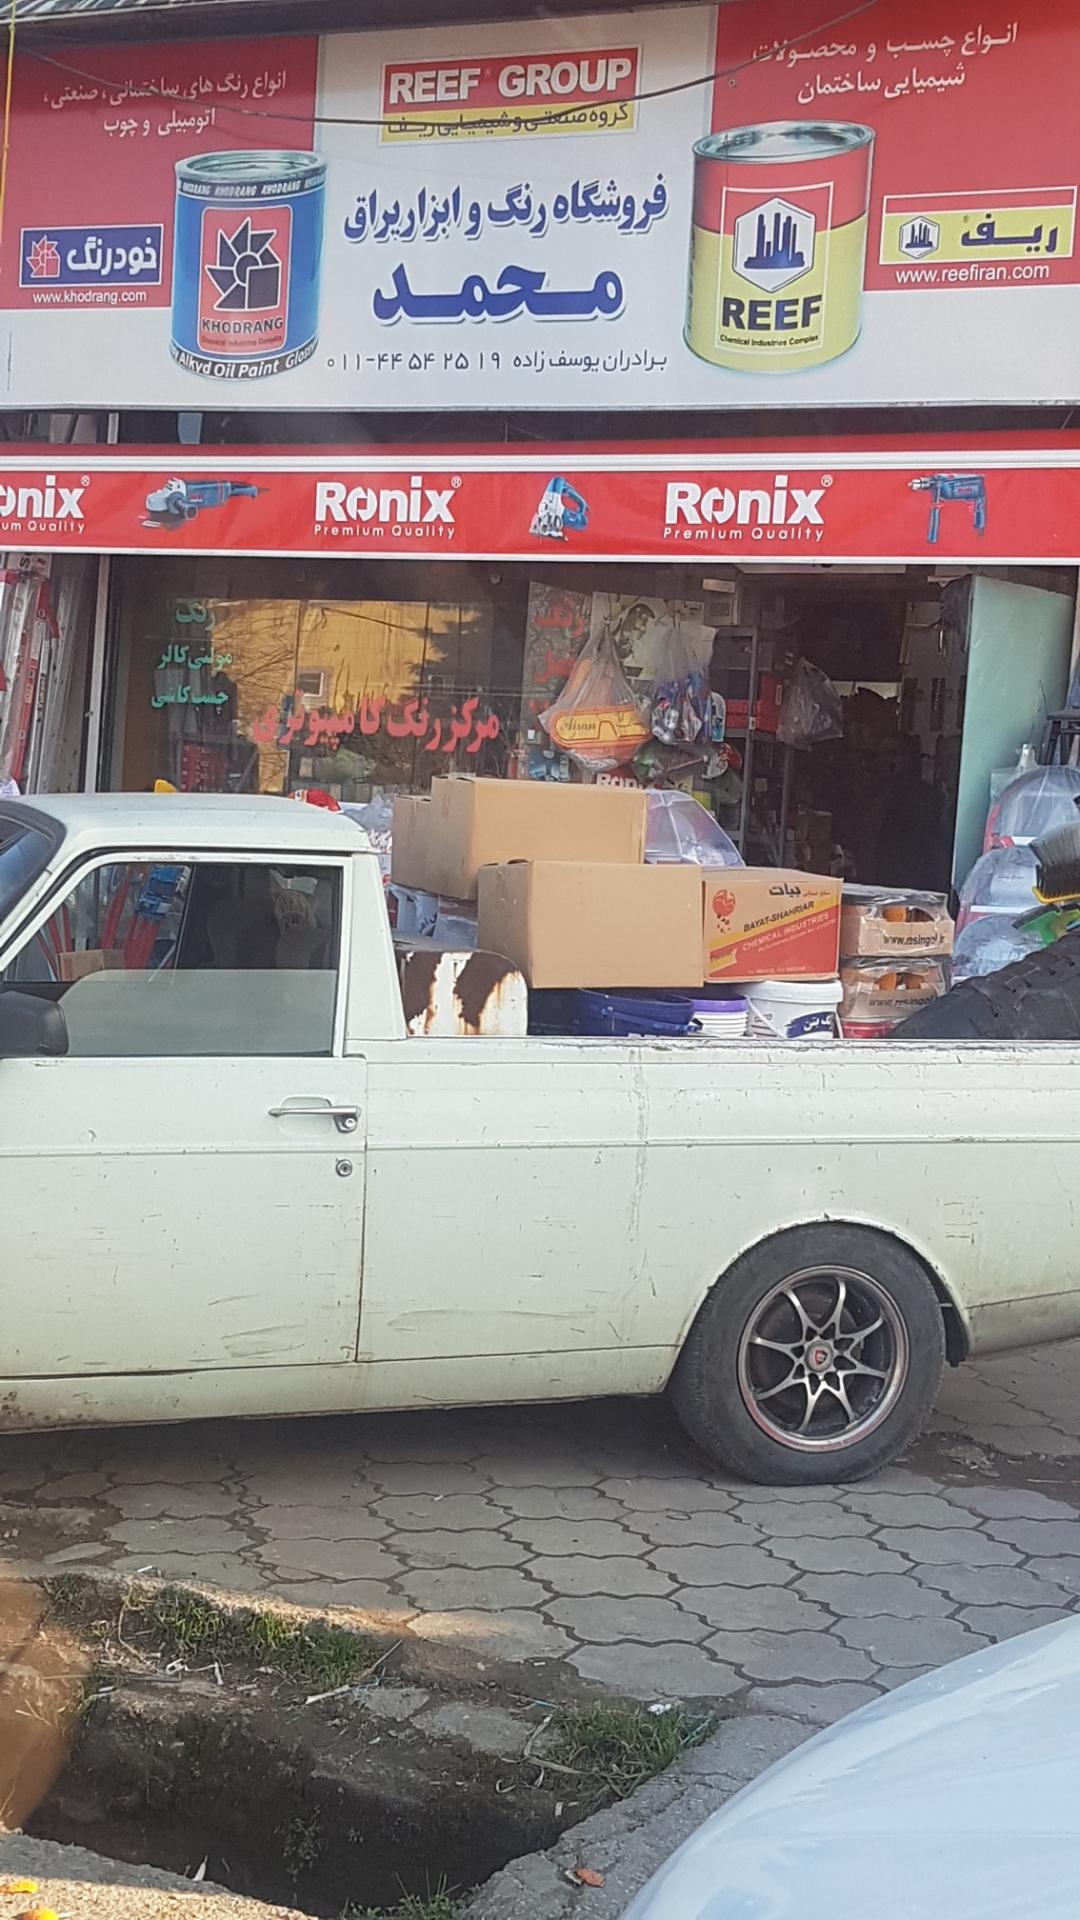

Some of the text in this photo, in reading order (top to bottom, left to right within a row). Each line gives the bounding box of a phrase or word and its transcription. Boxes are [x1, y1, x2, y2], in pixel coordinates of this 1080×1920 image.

[752, 22, 1018, 68] انواع چسب و محصولات
[183, 75, 213, 99] های
[217, 73, 249, 98] رنگ
[252, 70, 287, 98] انواع
[389, 58, 632, 104] REEF GROUP
[798, 63, 966, 105] شیمیایی ساختمان
[104, 107, 216, 137] اتومبیلی و چوب
[438, 110, 509, 137] شیمیایی
[524, 110, 587, 132] صنعتی
[590, 102, 629, 128] گروه
[214, 185, 257, 198] KHODRANG
[261, 180, 301, 195] KHODRANG
[552, 173, 667, 231] فروشگاه
[465, 201, 481, 236] و
[487, 183, 547, 234] رنگ
[961, 213, 1058, 253] ریف
[67, 236, 158, 276] خودرنگ
[896, 264, 1050, 284] www.reefiran.com
[32, 290, 147, 305] www.khodrang.com
[373, 262, 624, 320] محمد
[202, 317, 283, 334] KHODRANG
[721, 294, 823, 331] REEF
[719, 334, 750, 346] Chemical
[179, 352, 212, 375] Alkyd
[214, 364, 235, 378] Oil
[238, 361, 279, 378] Paint
[513, 350, 547, 372] زاده
[549, 350, 600, 373] یوسف
[603, 350, 667, 372] برادران
[0, 475, 86, 519] onix
[315, 475, 456, 522] Ronix
[665, 474, 826, 525] Ronix
[28, 520, 85, 533] Quality
[314, 524, 455, 539] Premium Quality
[663, 527, 824, 542] Premium Quality
[442, 696, 499, 752] مرکز
[768, 883, 801, 898] بیات
[743, 901, 815, 932] BAYAT-SHAHRIAR
[742, 931, 782, 952] CHEMICAL
